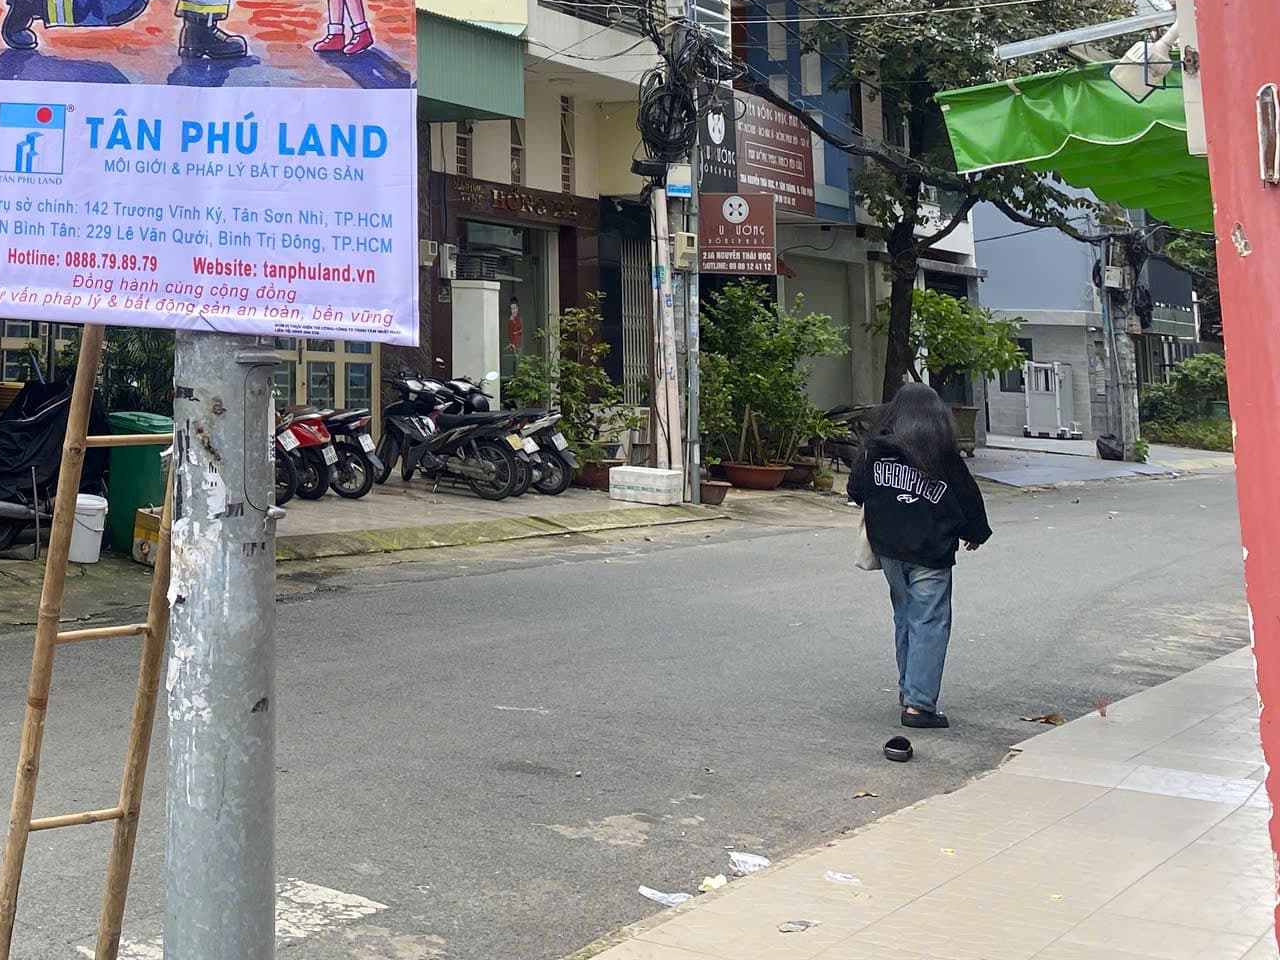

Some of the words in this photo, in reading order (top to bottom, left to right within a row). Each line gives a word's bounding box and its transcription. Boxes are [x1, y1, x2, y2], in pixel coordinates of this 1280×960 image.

[85, 108, 161, 152] TÂN
[181, 111, 258, 155] PHÚ
[278, 122, 388, 158] LAND
[104, 157, 130, 173] MÔI
[135, 158, 166, 175] GIỚI
[186, 161, 223, 177] PHÁP
[228, 161, 245, 177] LÝ
[284, 164, 328, 182] ĐỘNG
[333, 165, 364, 181] SẢN
[84, 201, 109, 216] 142
[114, 201, 163, 222] Trương
[169, 204, 200, 221] Vĩnh
[232, 207, 258, 222] Tân
[264, 208, 293, 224] Sơn
[334, 211, 393, 228] TP.HCM
[14, 219, 45, 236] Bình
[86, 224, 112, 239] 229
[117, 226, 134, 241] Lê
[219, 230, 251, 247] Bình
[281, 233, 325, 253] Đông,
[331, 236, 392, 253] TP.HCM
[8, 248, 60, 267] Hotline:
[65, 251, 158, 272] 0888.79.89.79
[193, 256, 257, 277] Website:
[263, 261, 376, 283] tanphuland.vn
[73, 273, 114, 291] Đồng
[120, 275, 159, 294] hành
[166, 281, 204, 299] cùng
[210, 284, 249, 301] cộng
[256, 283, 297, 304] đồng
[43, 291, 82, 307] pháp
[155, 297, 195, 315] động
[237, 306, 257, 317] an
[312, 305, 344, 322] bền
[351, 309, 394, 327] vững
